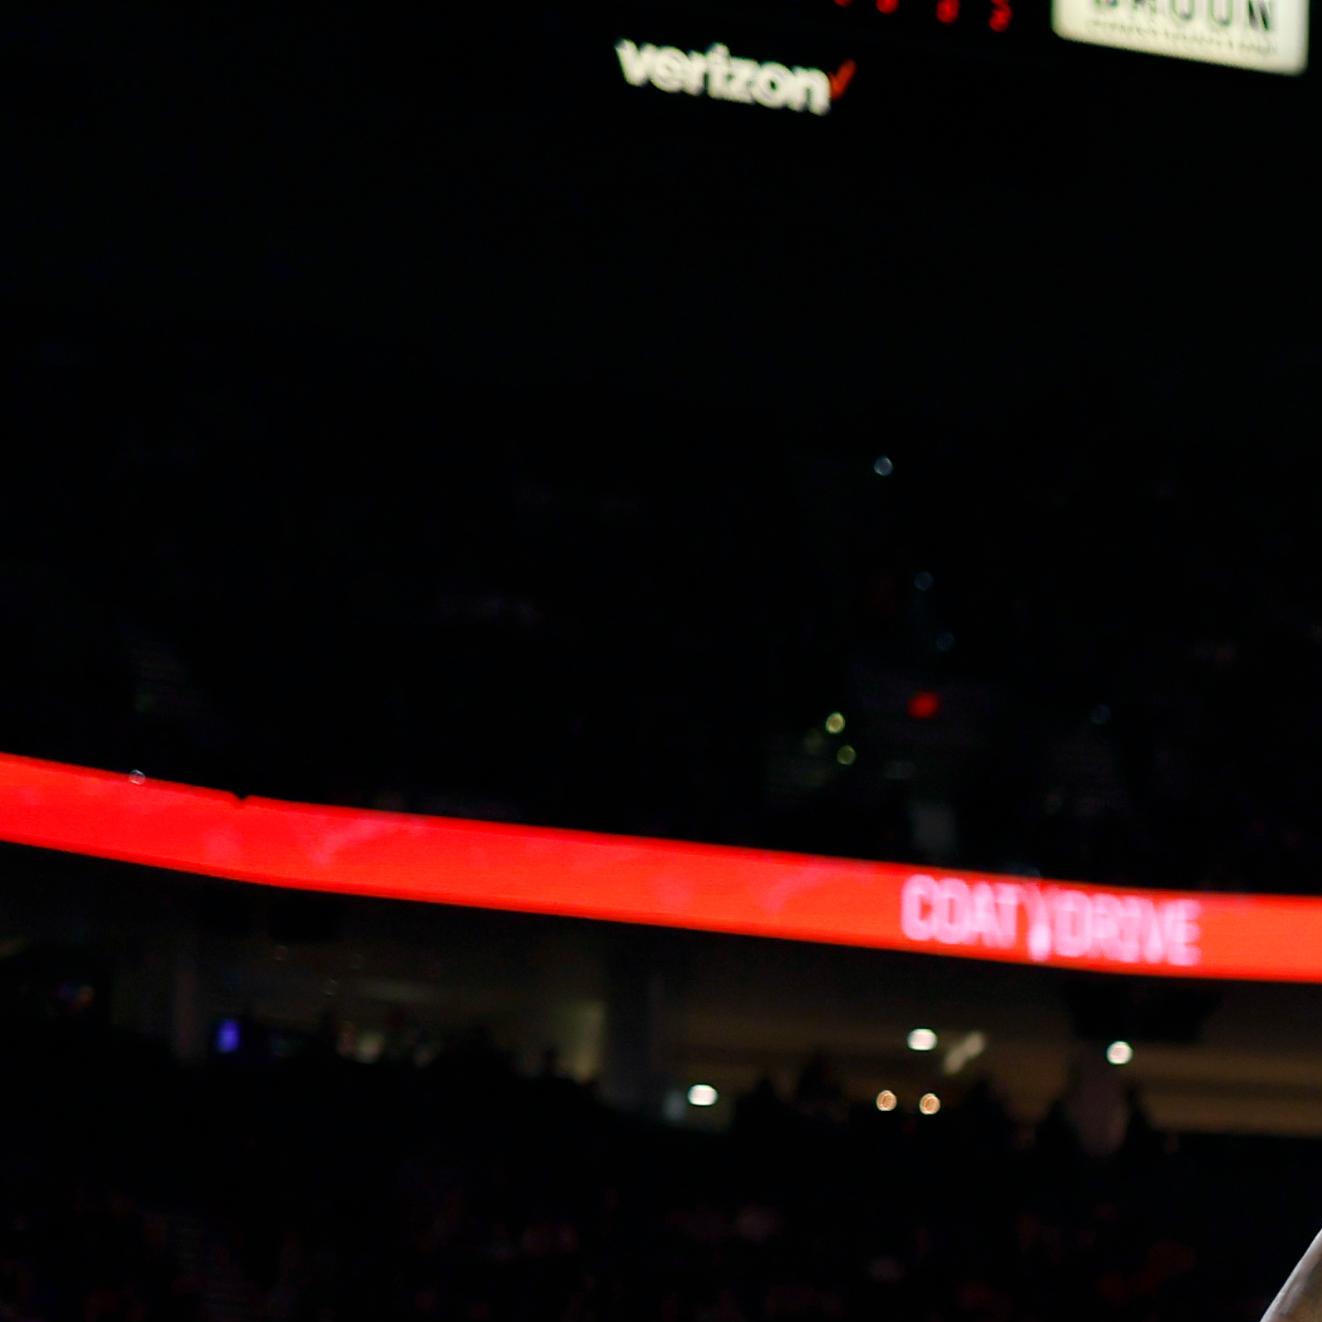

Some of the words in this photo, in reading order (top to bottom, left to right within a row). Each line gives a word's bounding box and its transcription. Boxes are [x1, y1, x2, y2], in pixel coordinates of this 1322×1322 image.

[614, 38, 831, 117] verizon
[901, 873, 1019, 949] COAT
[1051, 888, 1200, 967] DRIVE
